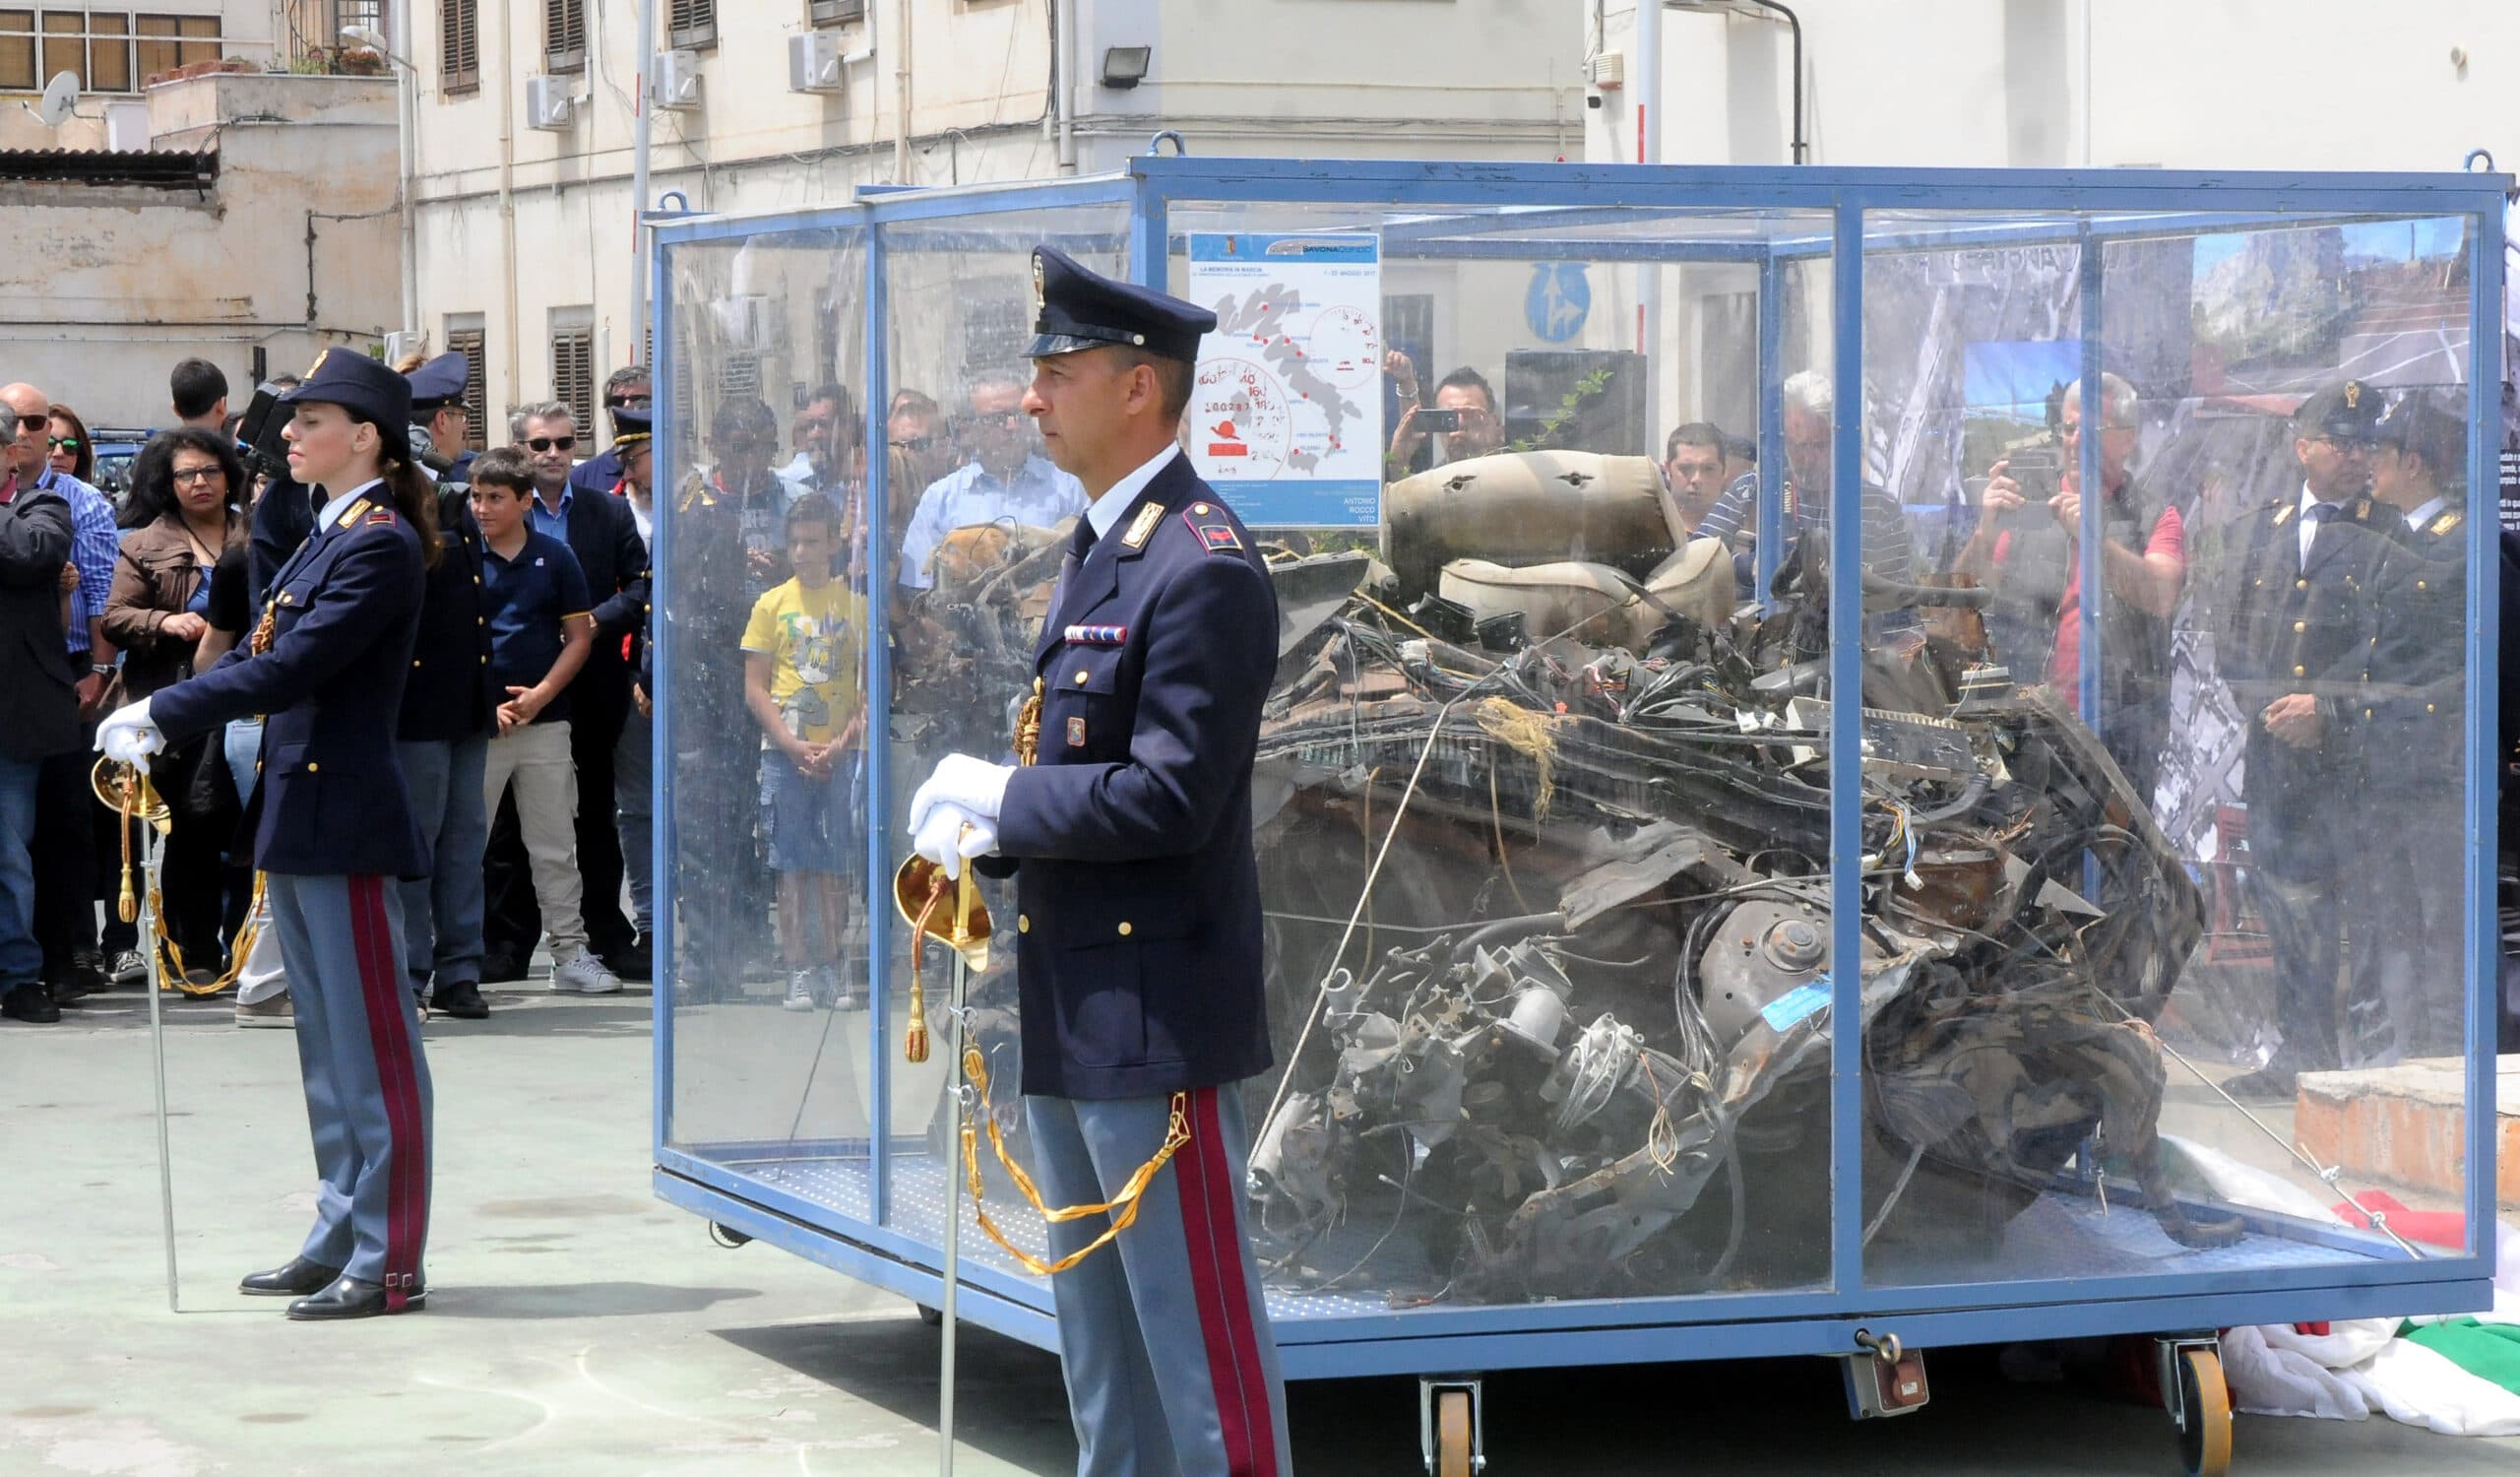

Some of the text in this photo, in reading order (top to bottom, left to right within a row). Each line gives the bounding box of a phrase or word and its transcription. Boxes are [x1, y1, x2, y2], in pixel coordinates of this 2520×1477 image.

[1343, 496, 1376, 505] ANTONIO
[1349, 505, 1376, 514] ROCCO
[1357, 515, 1376, 524] VITO
